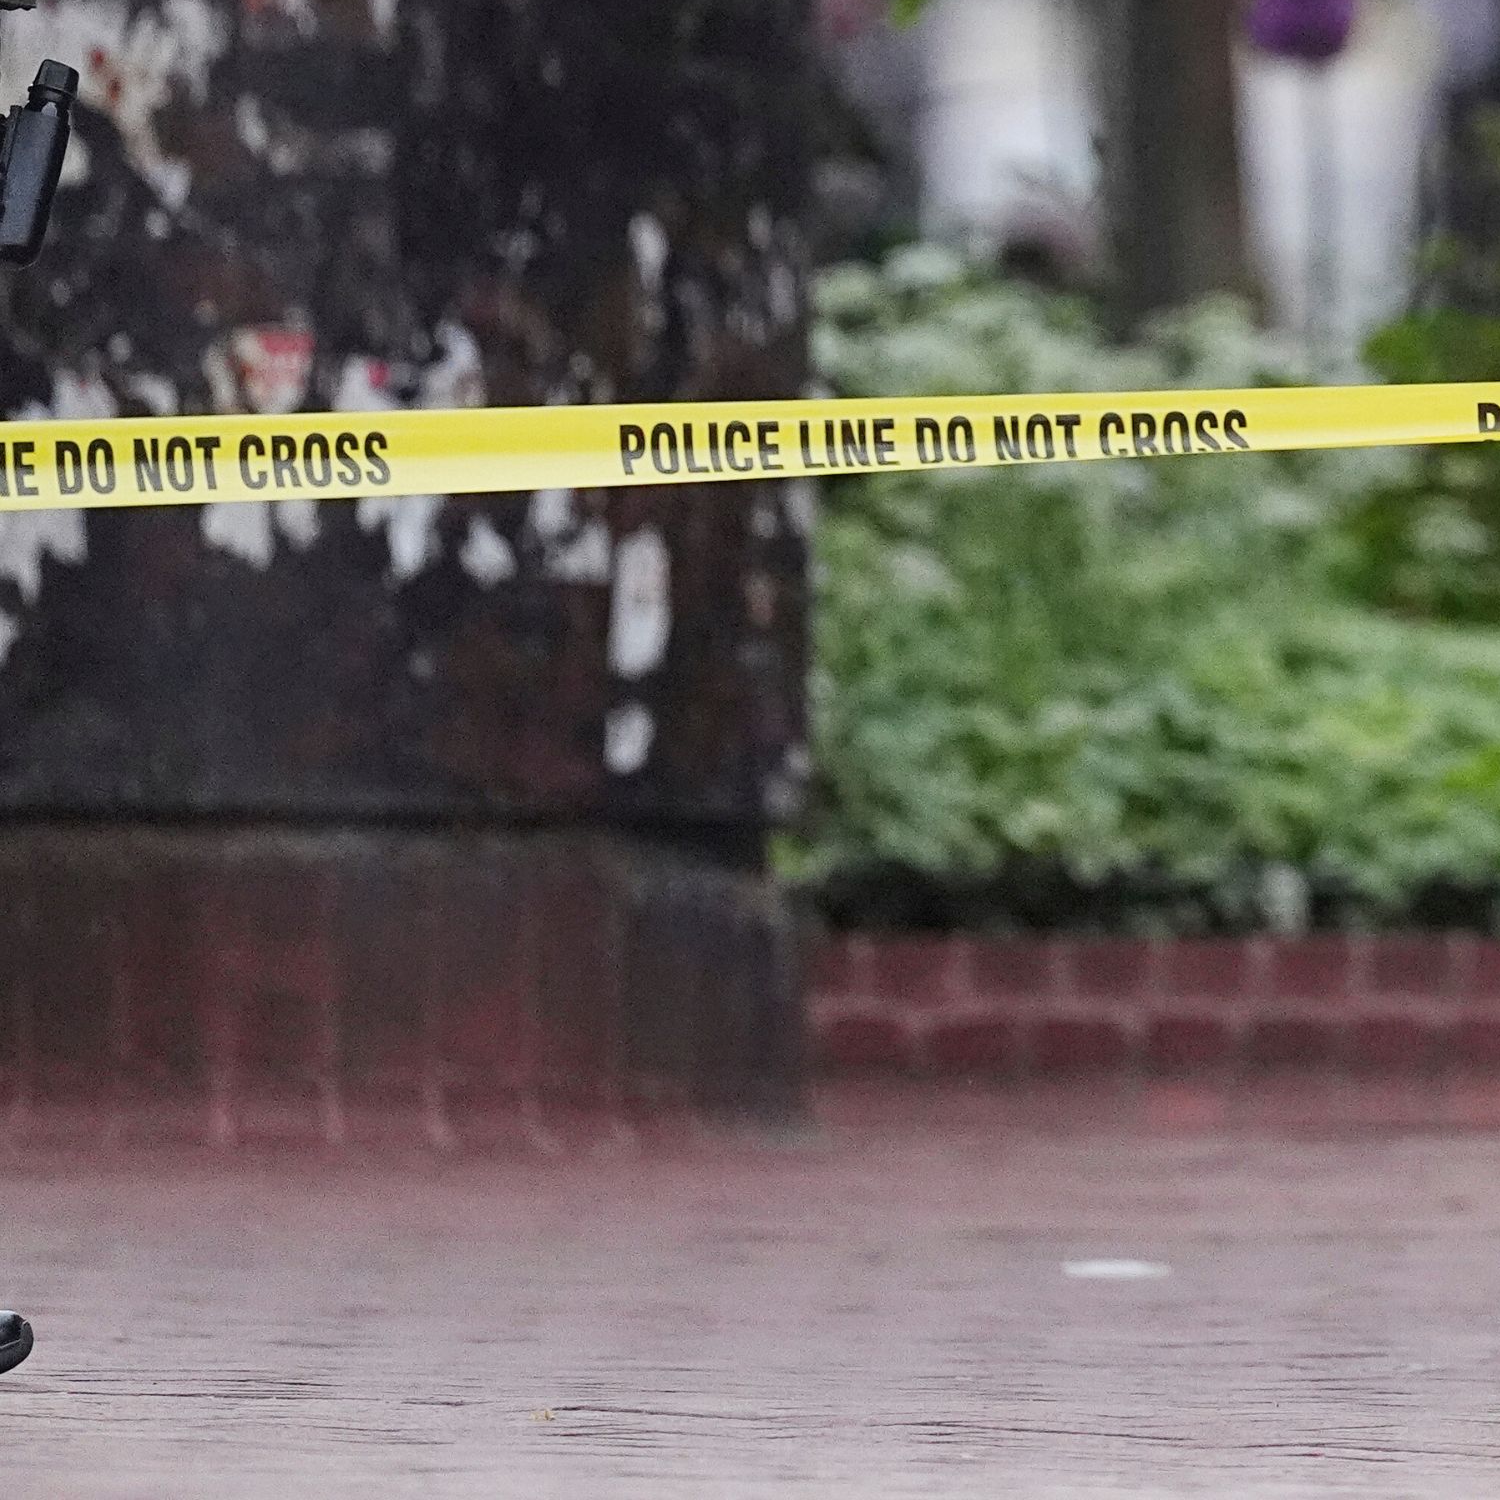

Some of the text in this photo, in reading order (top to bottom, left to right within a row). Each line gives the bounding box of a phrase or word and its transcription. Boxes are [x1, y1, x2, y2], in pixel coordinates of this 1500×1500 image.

[55, 438, 116, 496] DO
[133, 436, 220, 492] NOT
[239, 431, 391, 490] CROSS
[620, 409, 1250, 475] POLICE LINE DO NOT CROSS
